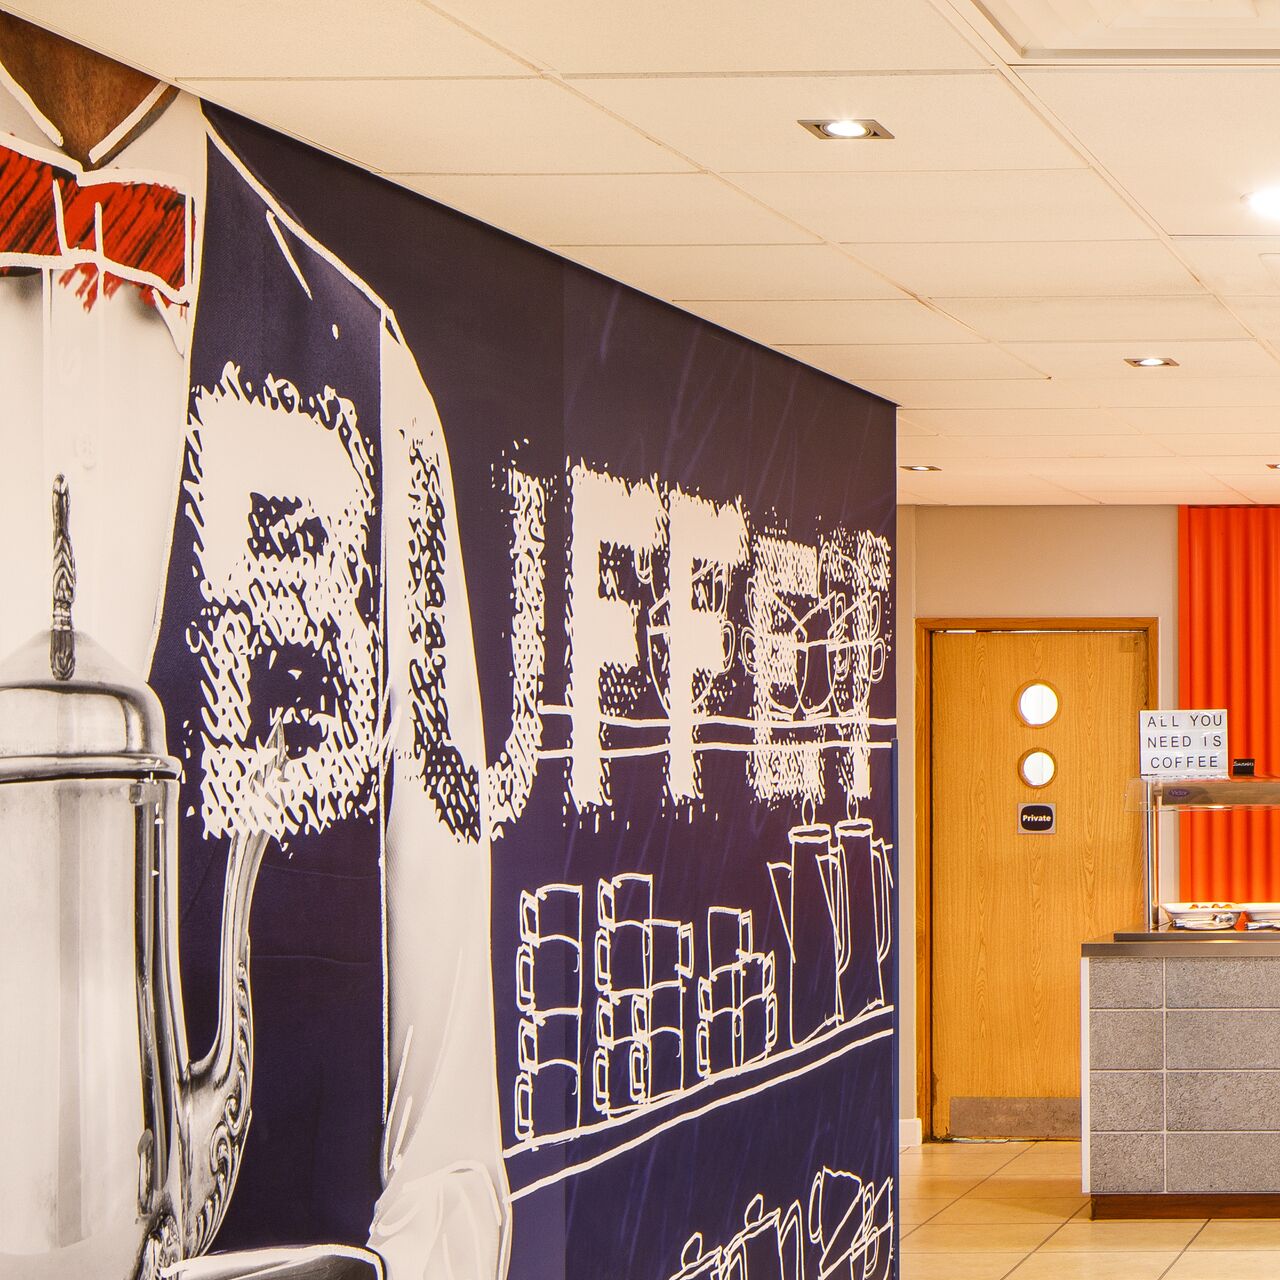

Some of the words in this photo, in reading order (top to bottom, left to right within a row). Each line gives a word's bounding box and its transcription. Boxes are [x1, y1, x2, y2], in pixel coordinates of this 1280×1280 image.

[185, 362, 891, 843] BUFFET
[1190, 715, 1222, 727] YOU
[1147, 736, 1192, 748] NEED
[1204, 735, 1222, 747] IS
[1150, 756, 1218, 769] COFFEE
[1022, 814, 1052, 822] Private
